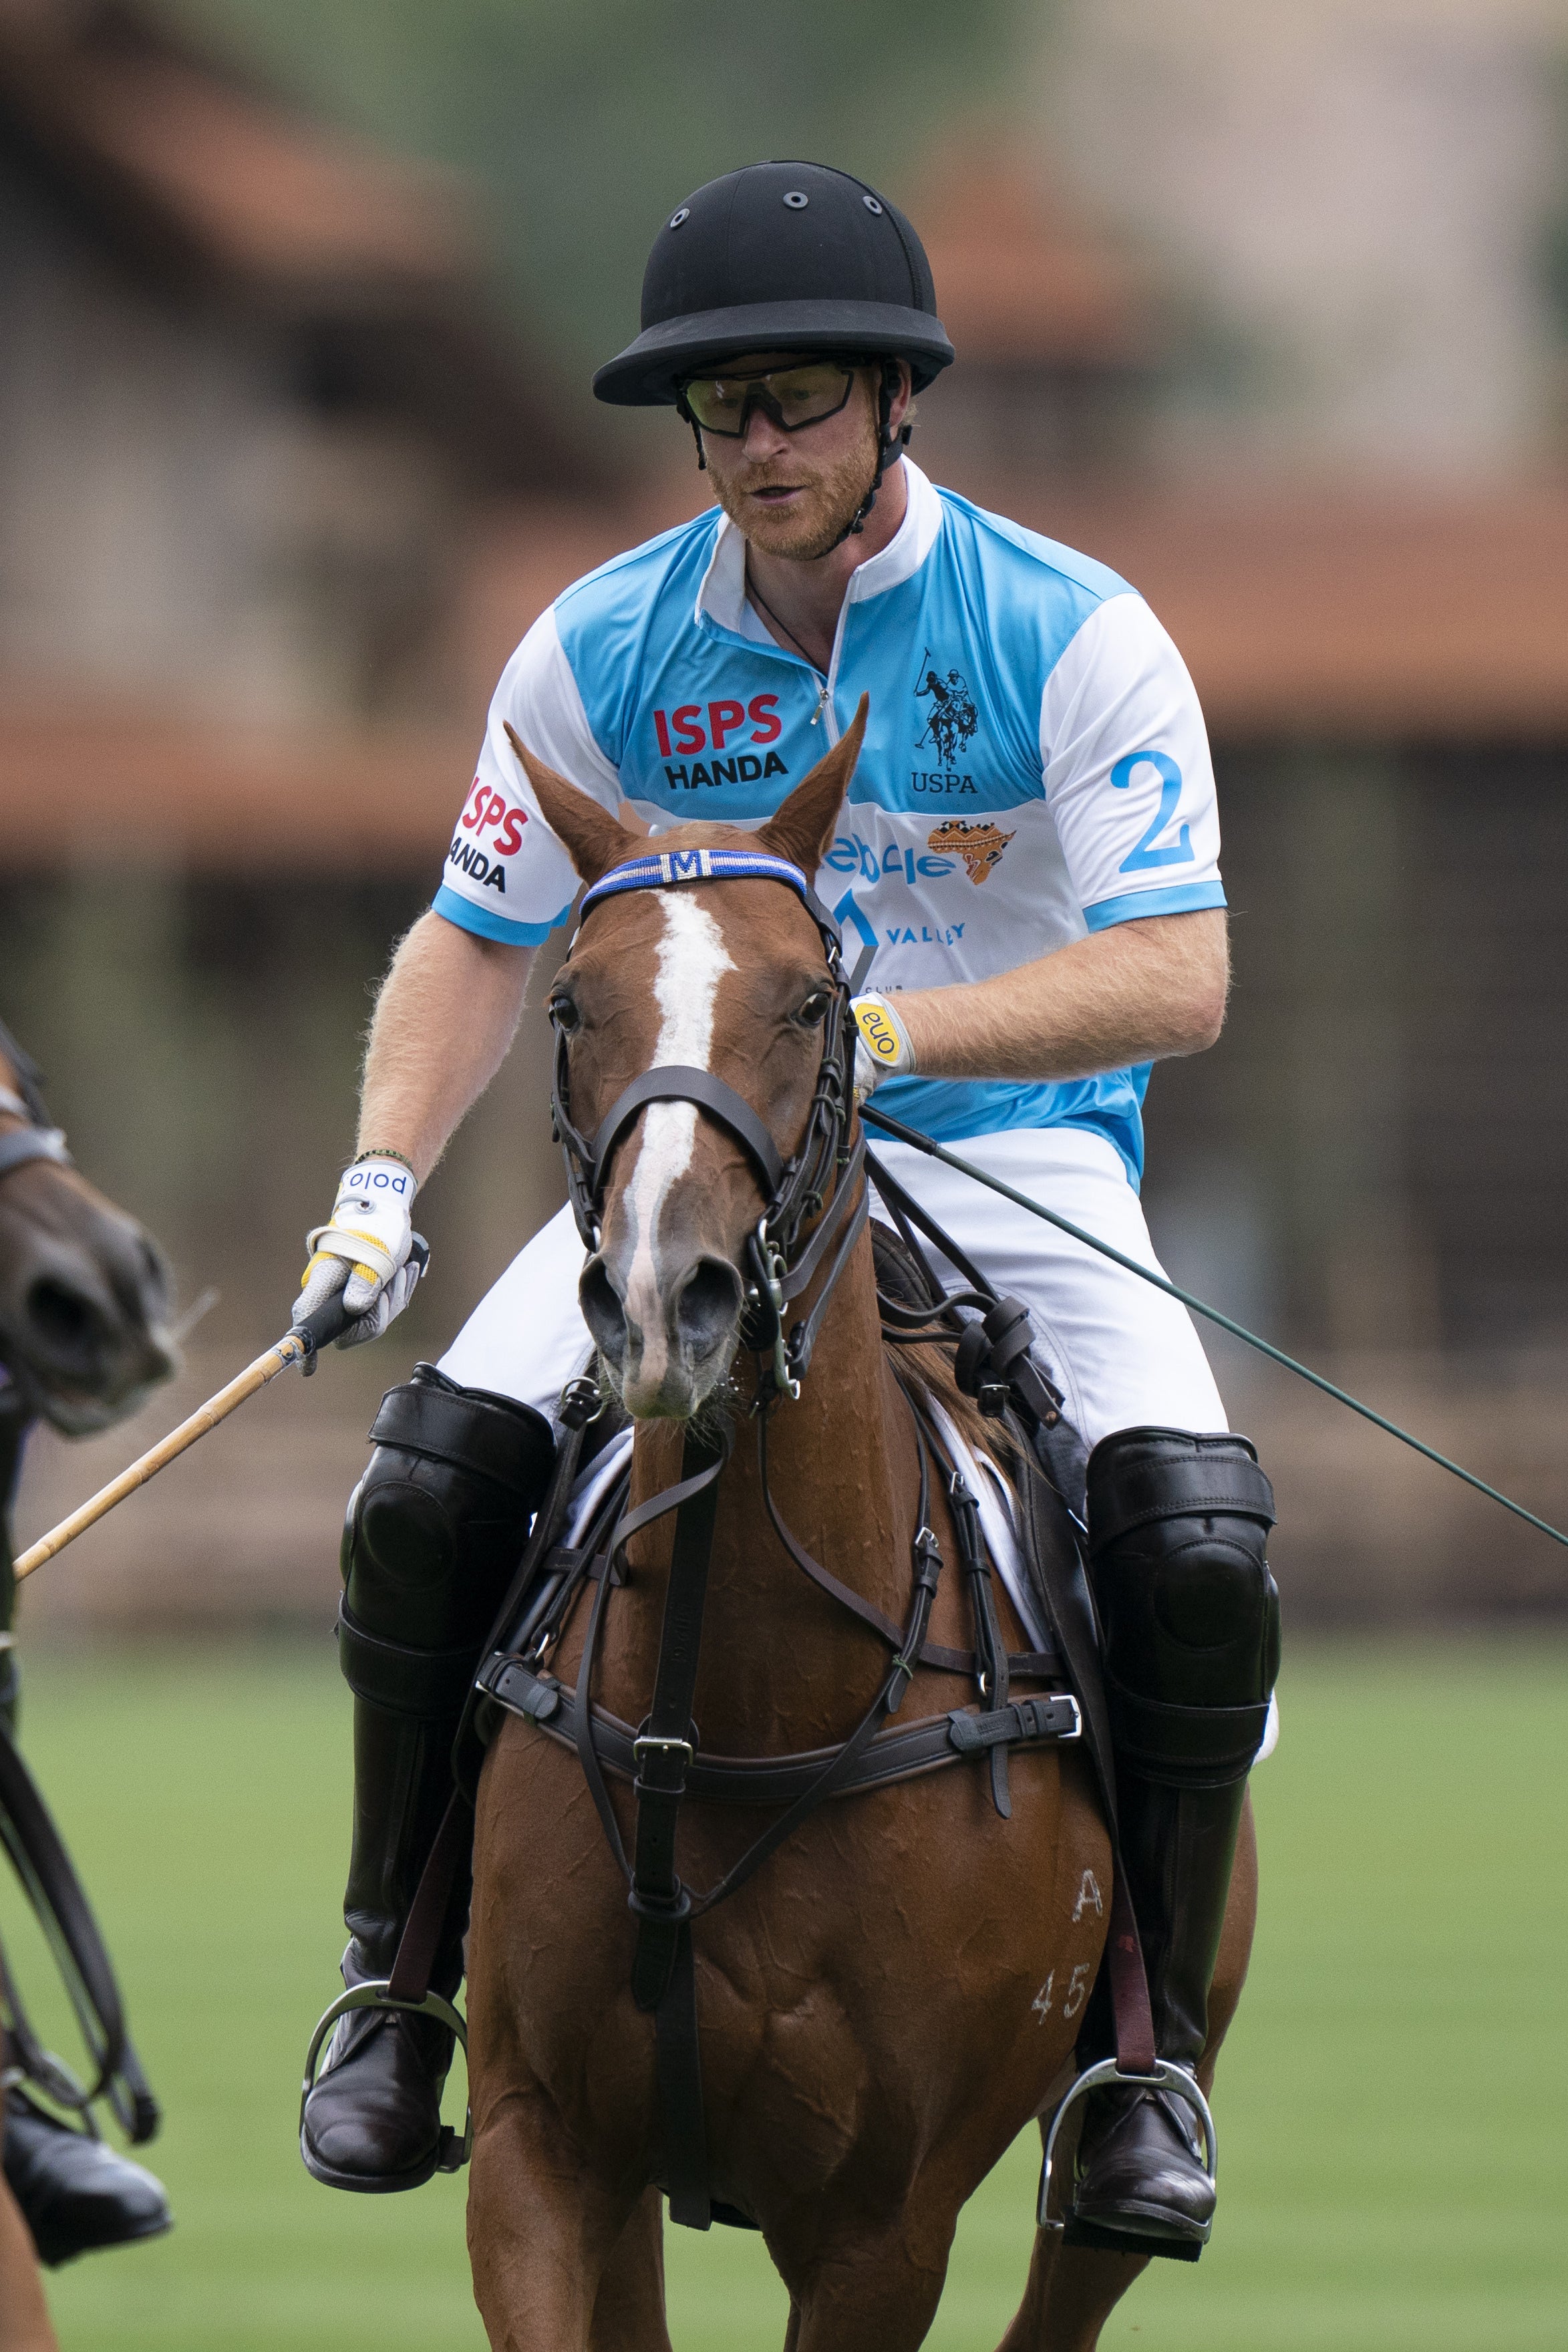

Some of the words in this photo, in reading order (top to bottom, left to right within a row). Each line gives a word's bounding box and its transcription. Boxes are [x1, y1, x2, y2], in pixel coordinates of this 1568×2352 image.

[653, 694, 782, 757] ISPS
[663, 751, 788, 789] HANDA
[911, 772, 978, 793] USPA
[1110, 750, 1195, 873] 2
[449, 837, 505, 893] ANDA
[669, 849, 701, 881] M
[863, 1012, 895, 1054] ona
[350, 1173, 407, 1194] polo
[1072, 1870, 1102, 1922] A
